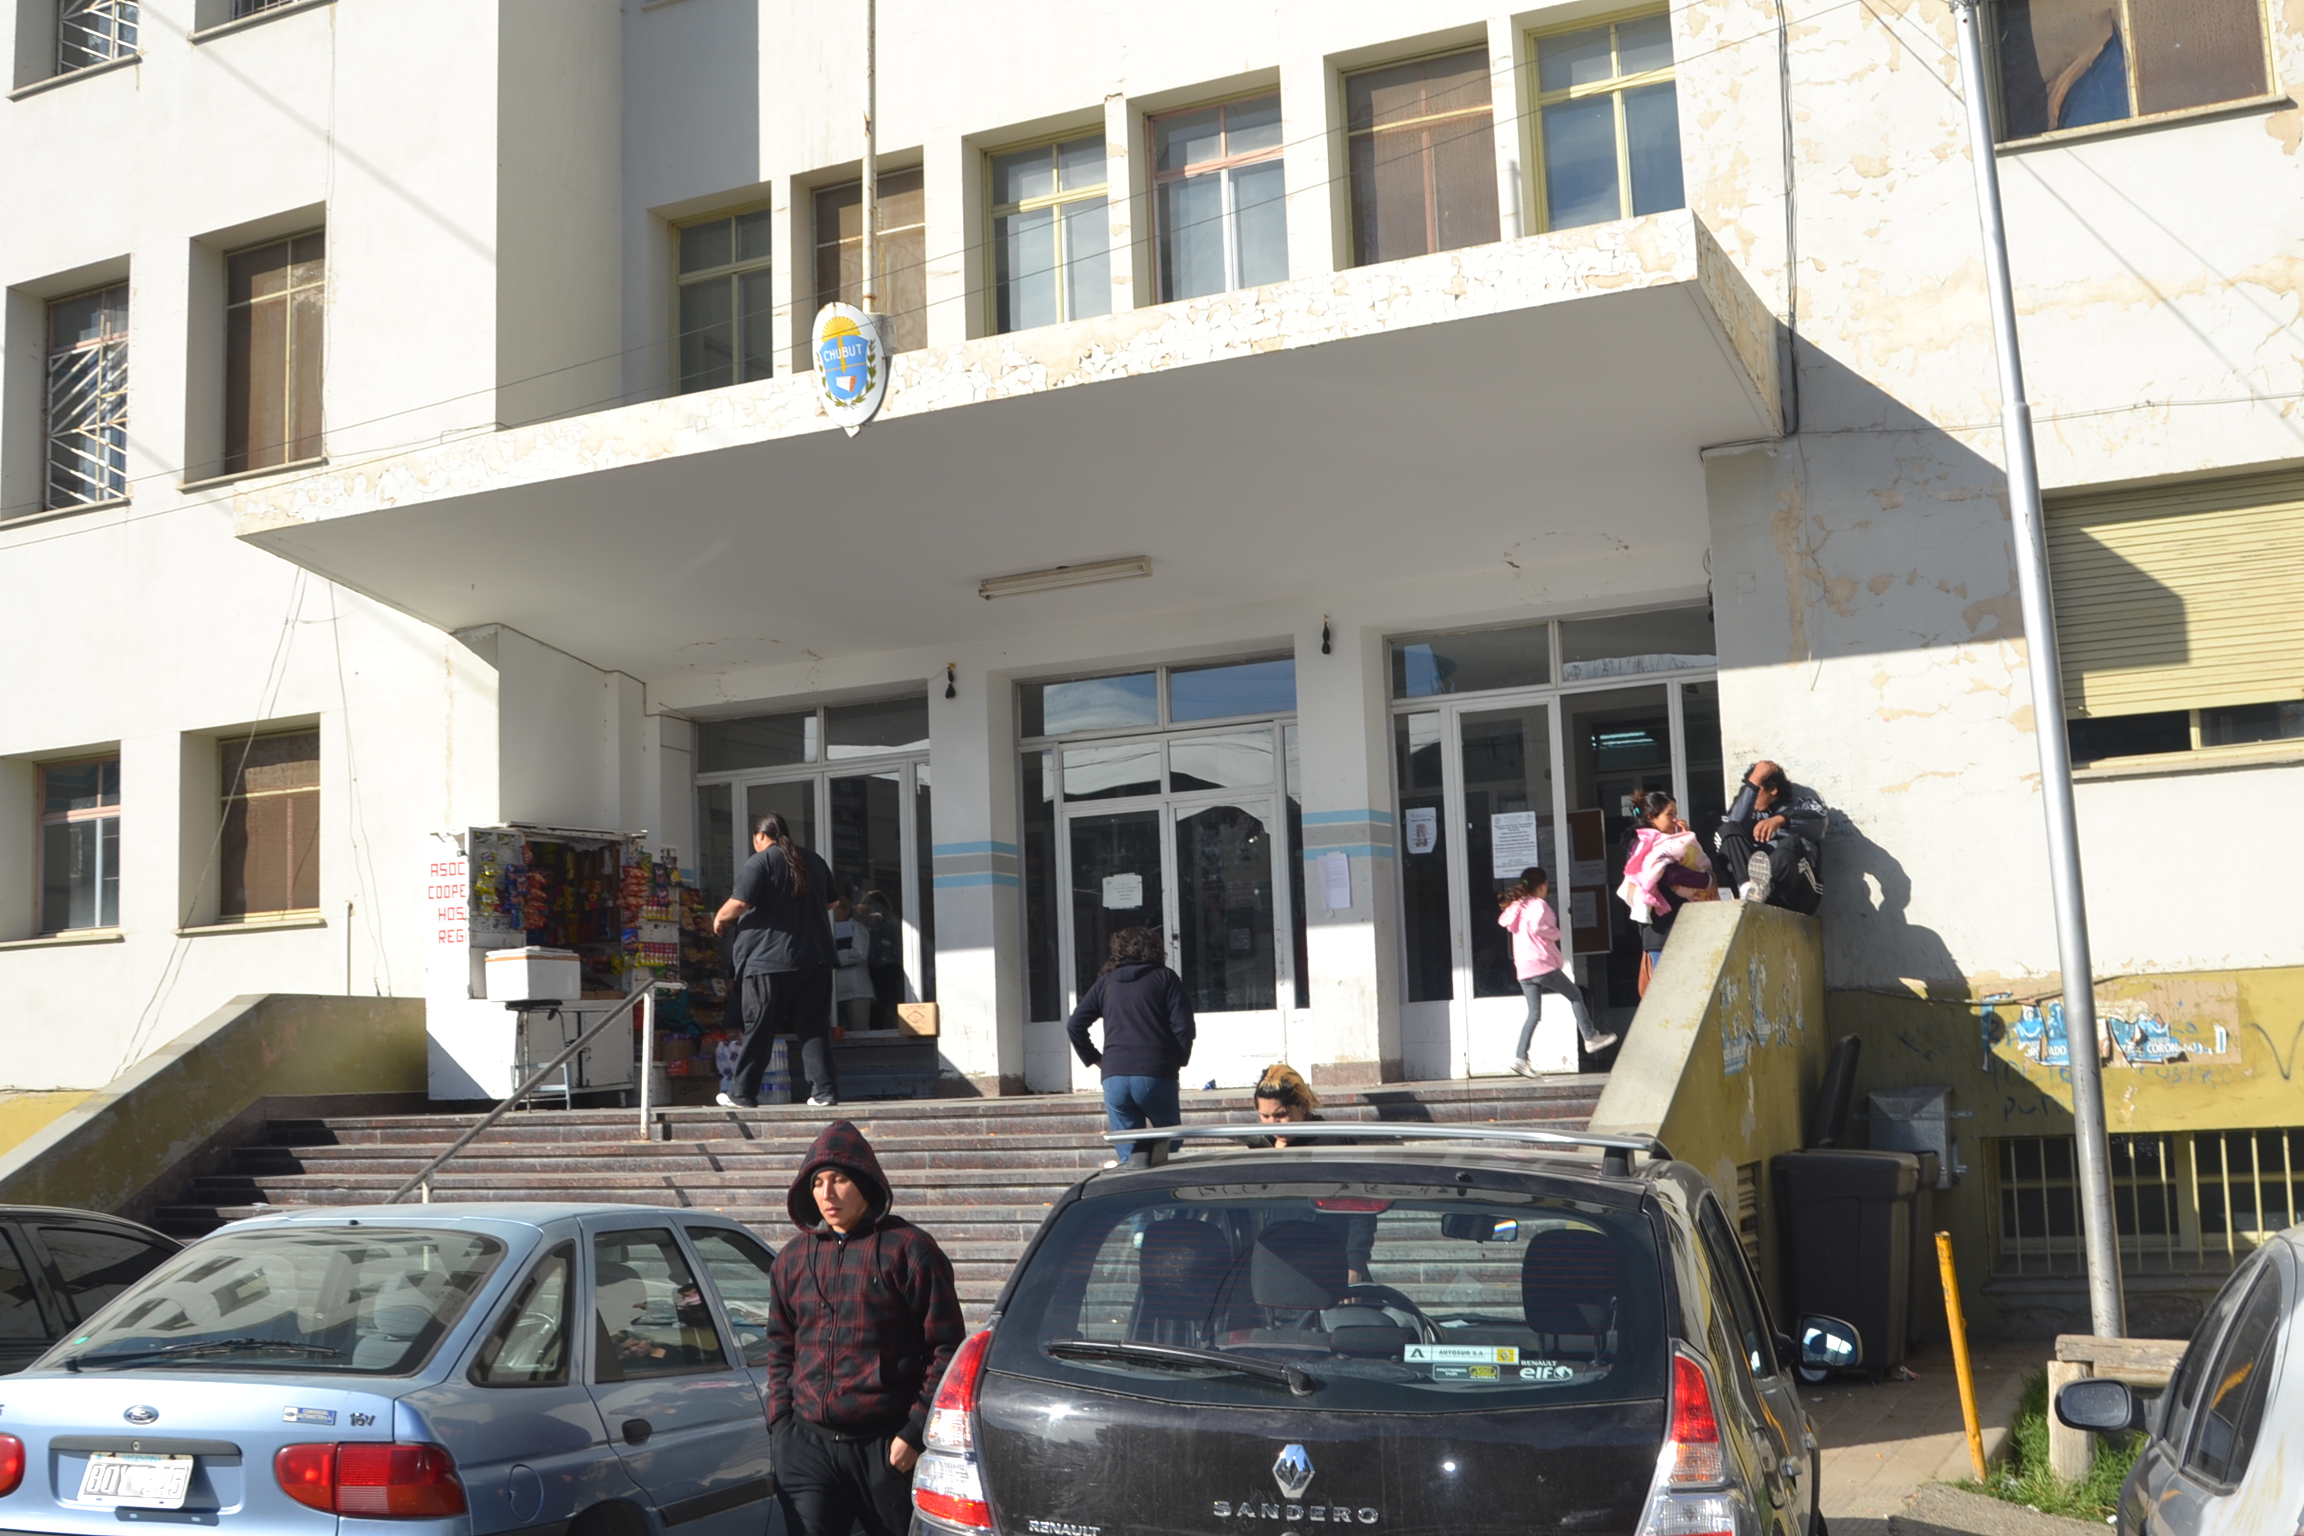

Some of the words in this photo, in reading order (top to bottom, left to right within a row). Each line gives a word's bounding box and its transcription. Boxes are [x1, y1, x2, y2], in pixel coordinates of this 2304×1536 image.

[823, 344, 863, 362] CHUBUT
[430, 862, 466, 877] ASOC
[427, 884, 467, 899] COOPE
[1519, 1366, 1554, 1379] elf
[1213, 1500, 1379, 1524] SANDERO
[1028, 1520, 1101, 1536] RENAULT
